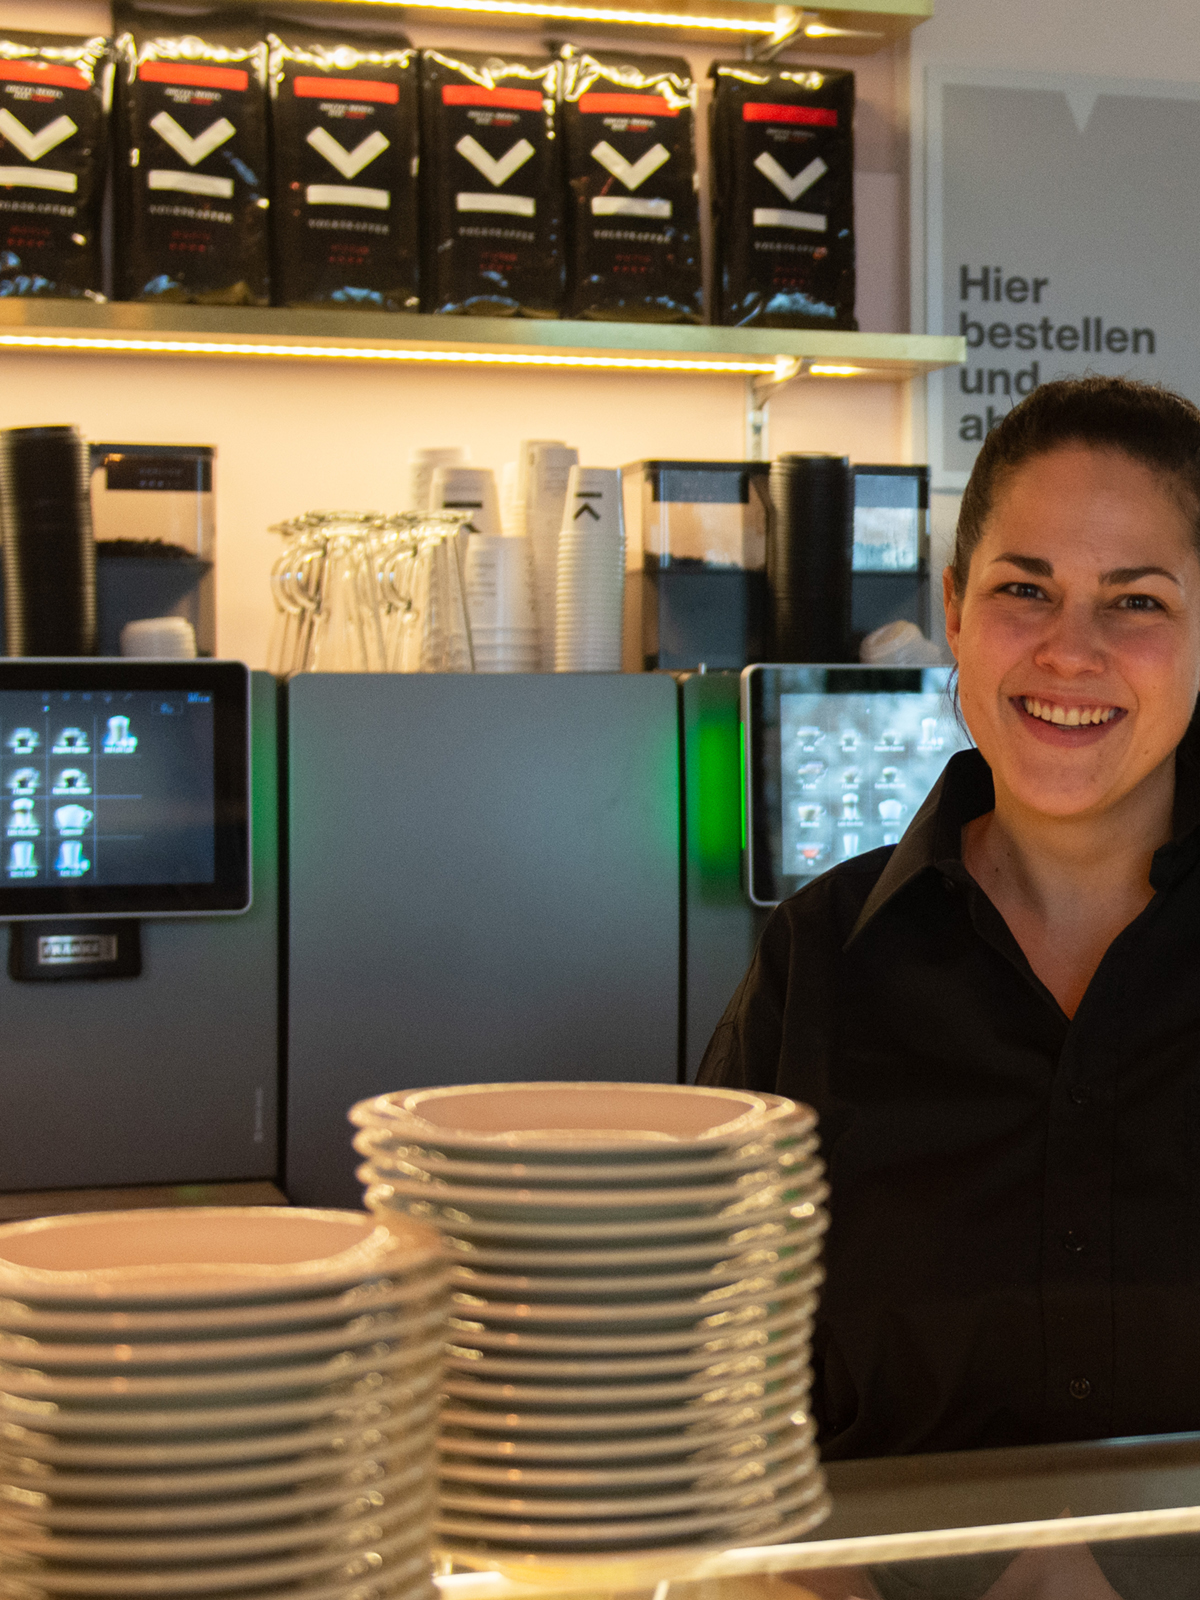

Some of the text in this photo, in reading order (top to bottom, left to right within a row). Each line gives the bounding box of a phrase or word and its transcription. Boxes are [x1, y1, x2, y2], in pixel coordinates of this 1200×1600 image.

[959, 264, 1049, 303] Hier
[959, 311, 1157, 354] bestellen
[959, 361, 1041, 396] und
